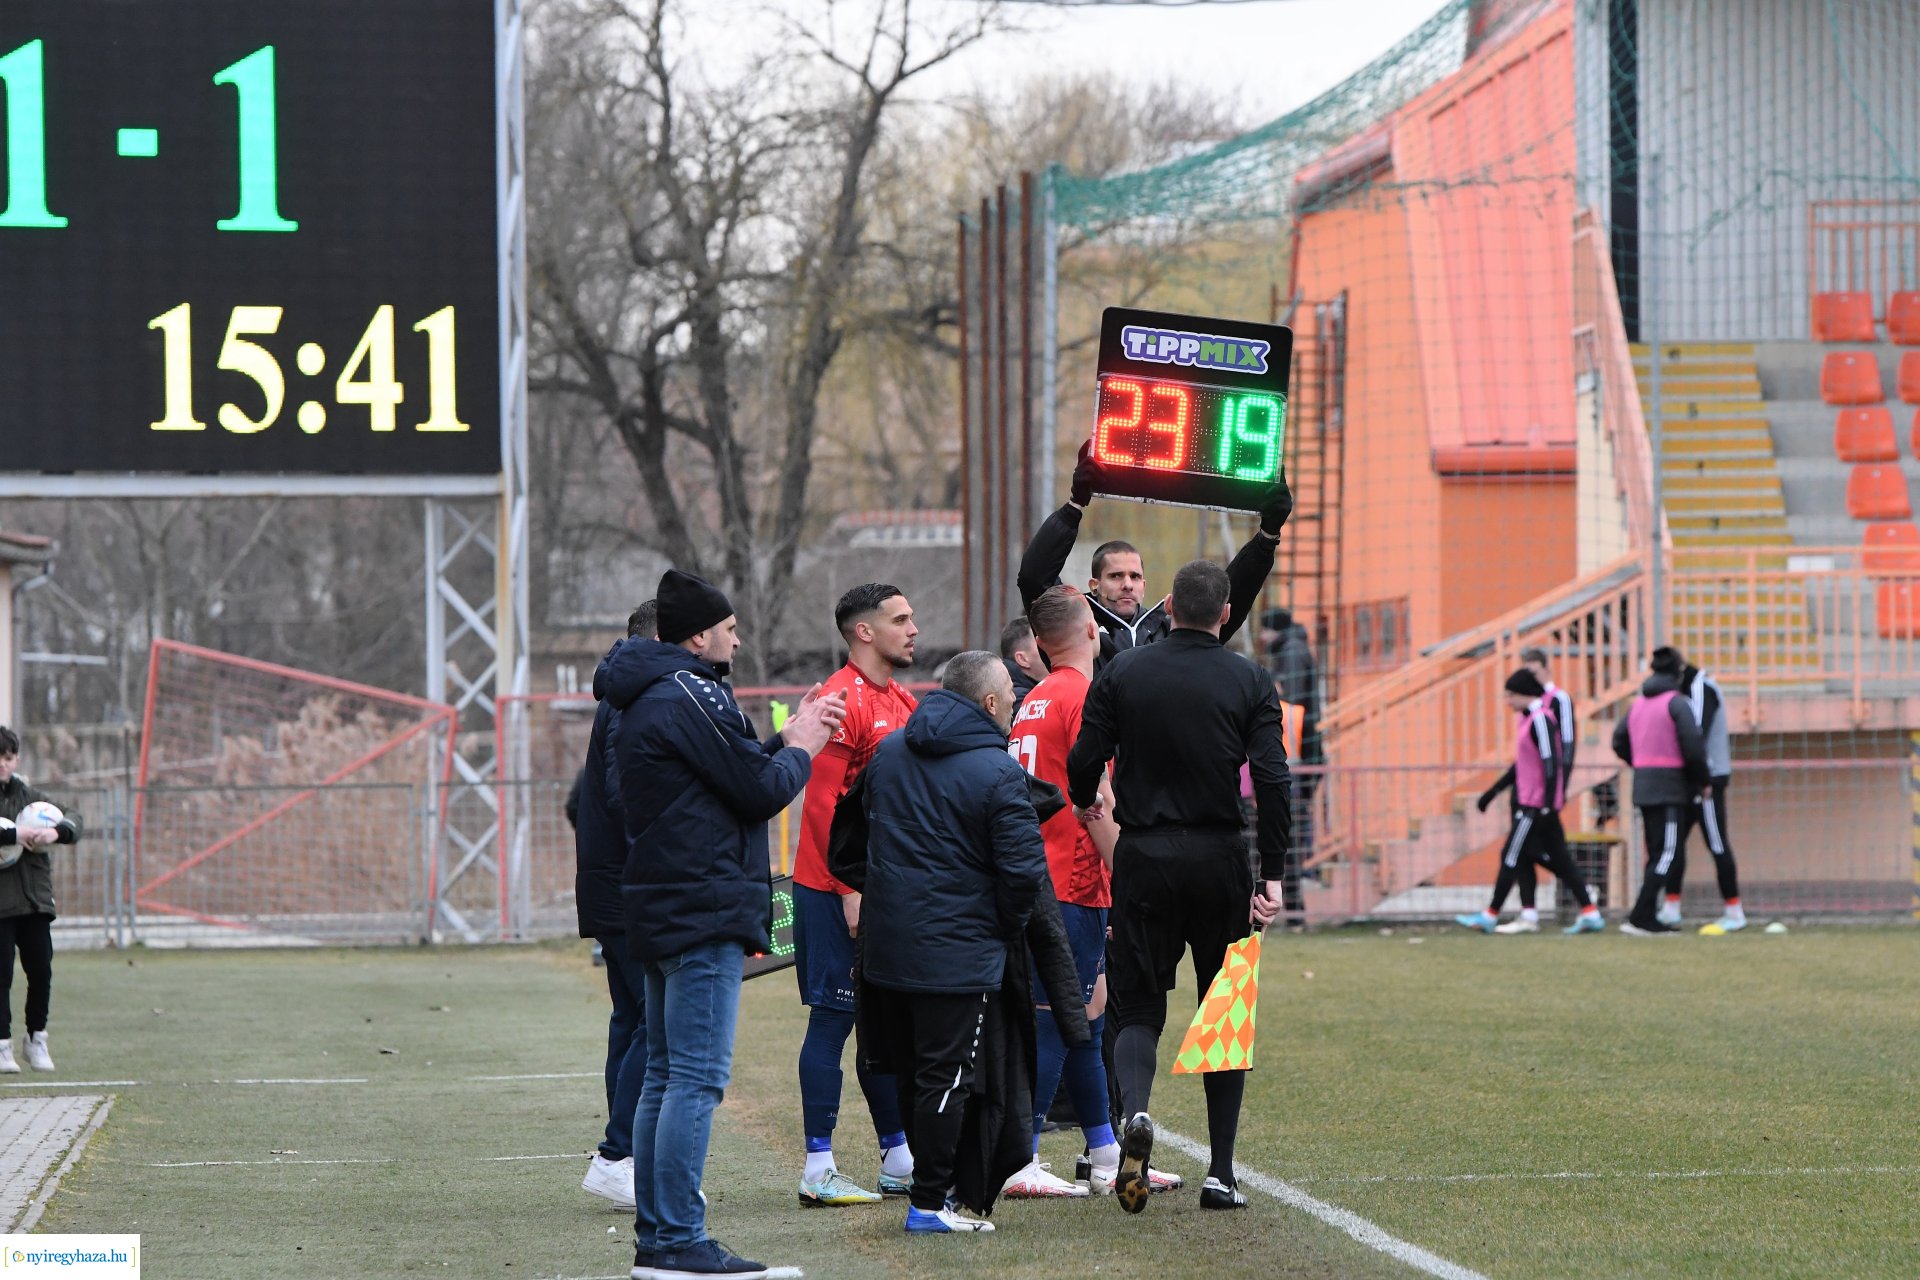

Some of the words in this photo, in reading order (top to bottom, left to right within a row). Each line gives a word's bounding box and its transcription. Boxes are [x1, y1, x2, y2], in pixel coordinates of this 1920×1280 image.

[0, 39, 68, 227] 1
[117, 128, 158, 156] -
[213, 45, 298, 231] 1
[148, 303, 469, 434] 15:41
[1097, 380, 1188, 469] 23
[1218, 393, 1280, 481] 19
